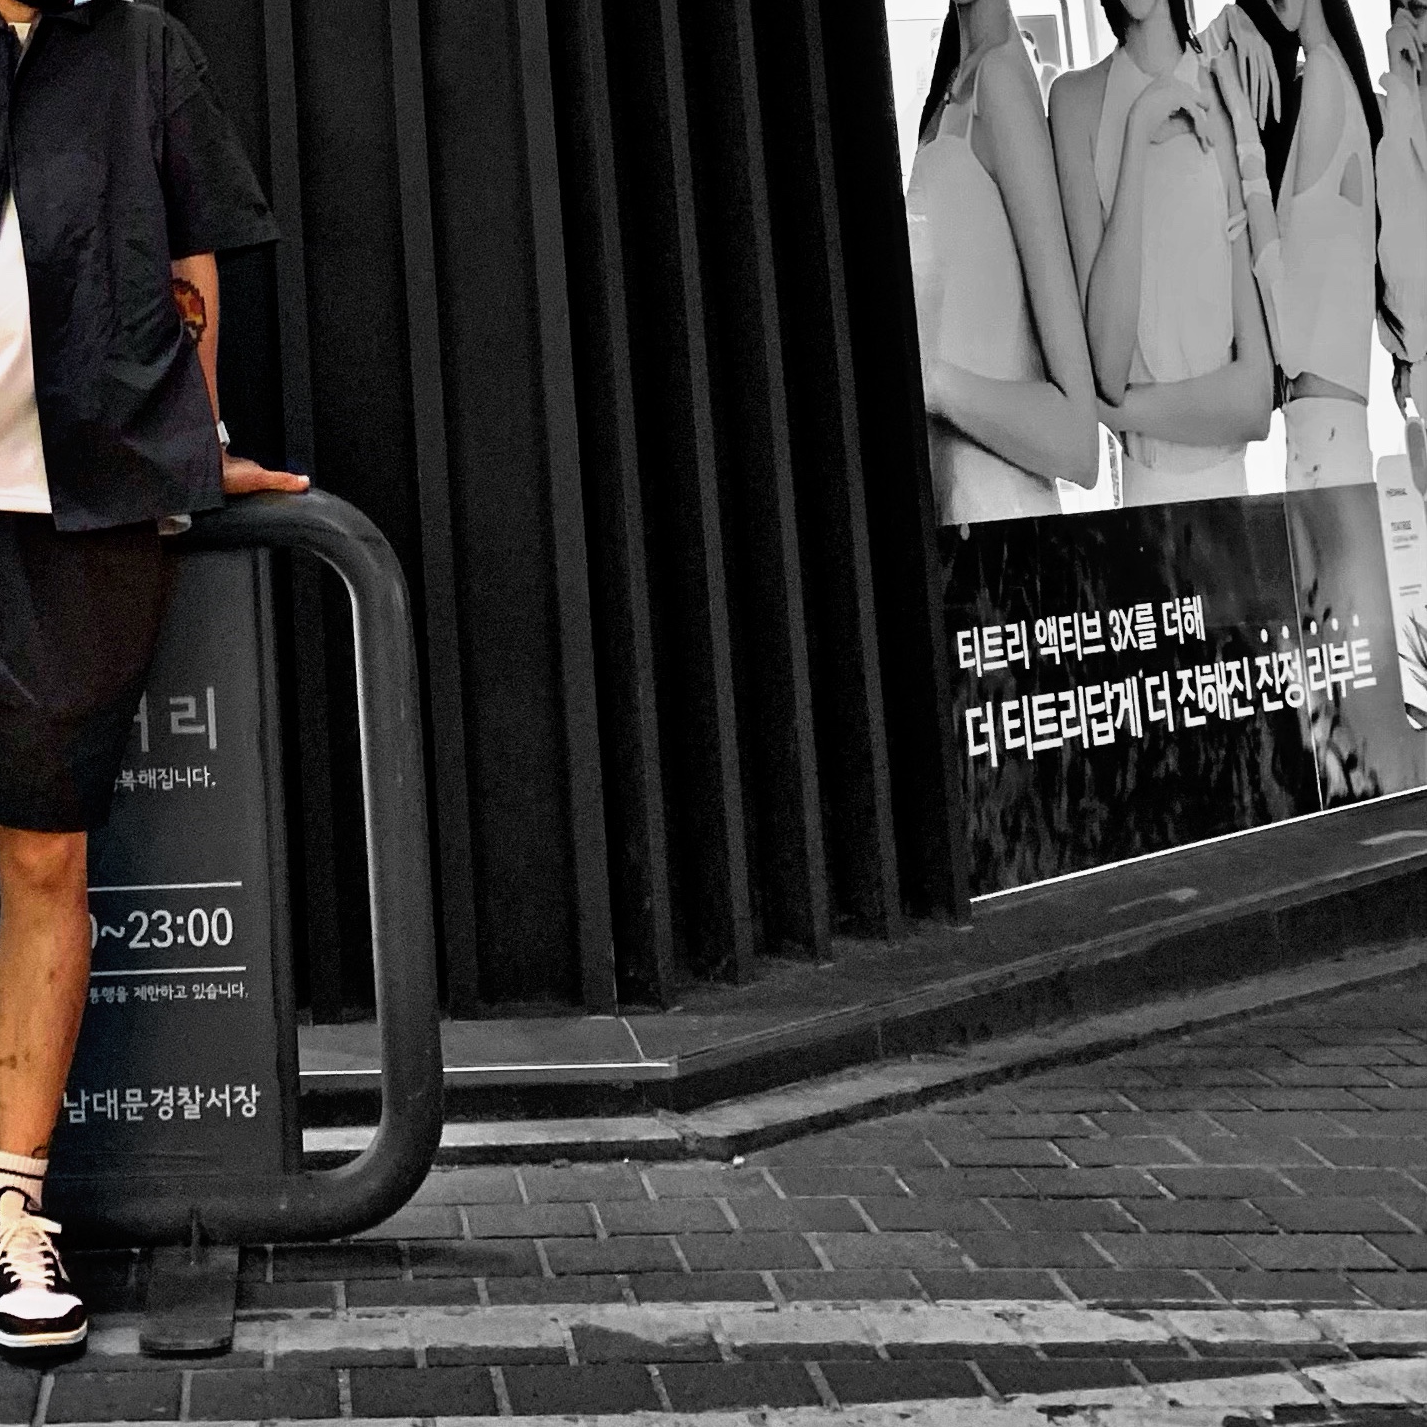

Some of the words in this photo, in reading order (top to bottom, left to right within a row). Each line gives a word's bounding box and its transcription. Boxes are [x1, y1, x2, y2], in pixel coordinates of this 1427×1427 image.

[957, 619, 1030, 677] 티트리
[1034, 610, 1106, 661] 액티브
[1108, 602, 1158, 652] 3X를
[1161, 594, 1206, 644] 더해
[965, 701, 998, 767] 더
[1001, 675, 1144, 760] 티트리답게
[1144, 670, 1174, 732] 더
[1177, 656, 1255, 728] 진해진
[114, 765, 217, 792] 복해집니다.
[63, 1084, 262, 1124] 남대문경찰서장
